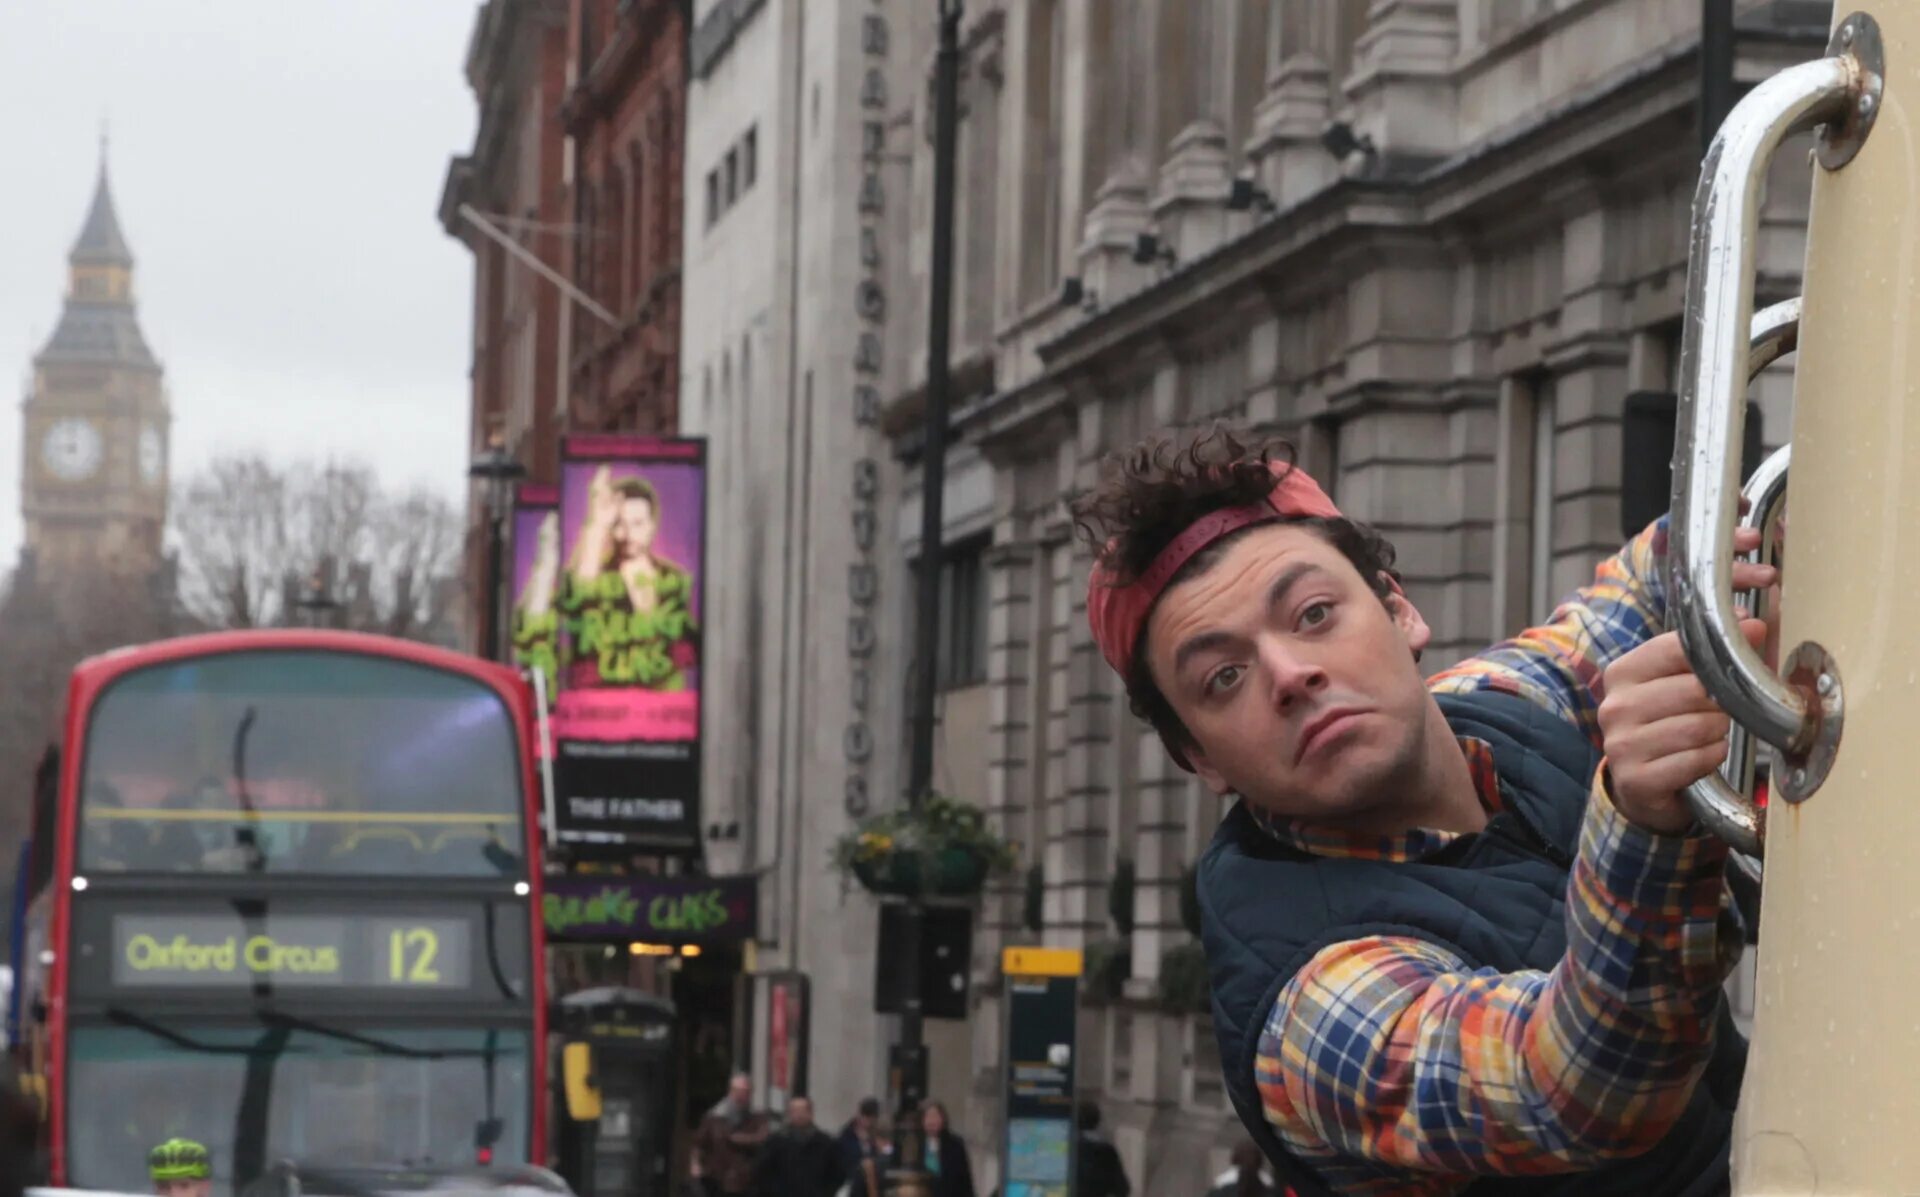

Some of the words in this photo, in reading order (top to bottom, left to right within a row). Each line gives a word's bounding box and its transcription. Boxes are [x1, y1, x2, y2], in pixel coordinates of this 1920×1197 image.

[854, 0, 888, 427] RAFALGAR
[843, 457, 878, 819] STUDIOS
[568, 797, 605, 819] THE
[608, 799, 684, 820] FATHER
[127, 933, 236, 971] Oxford
[244, 935, 340, 973] Circus
[388, 927, 441, 983] 12
